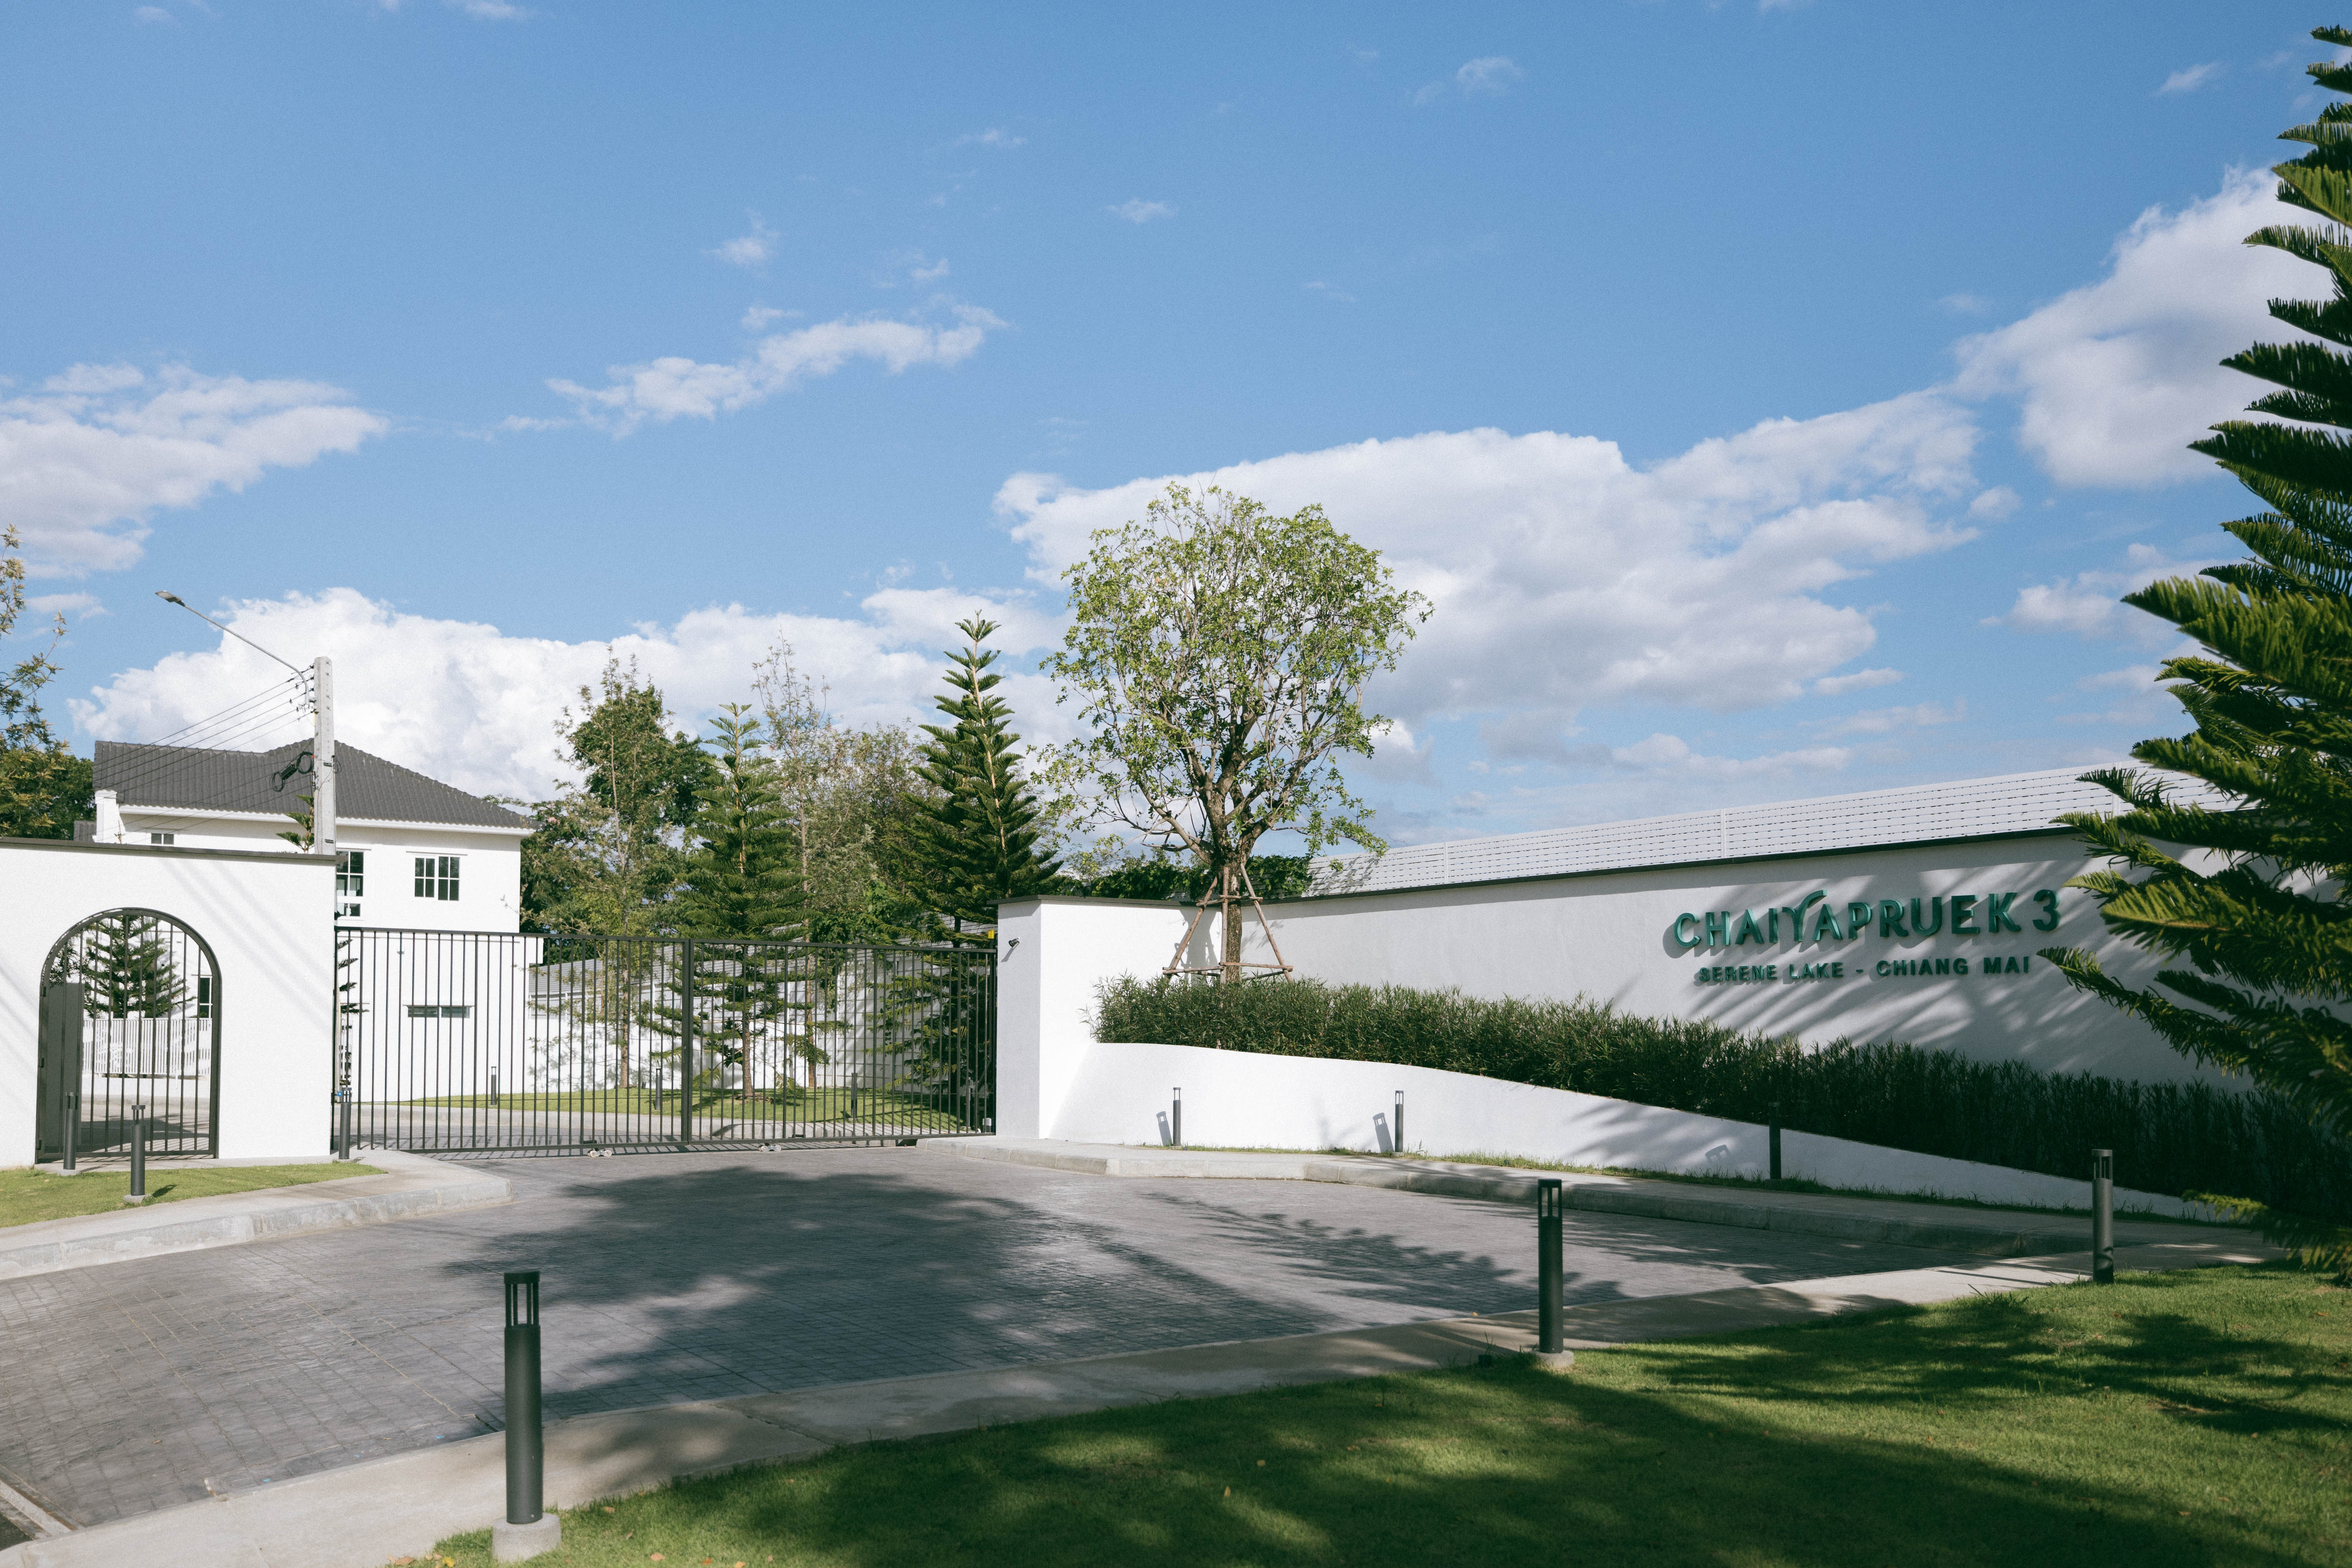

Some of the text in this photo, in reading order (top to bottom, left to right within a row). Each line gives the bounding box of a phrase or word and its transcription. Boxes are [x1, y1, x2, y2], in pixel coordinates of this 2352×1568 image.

[1673, 889, 2061, 948] CHAIYAPRUEK 3
[1699, 965, 1778, 982] SERENE
[1789, 962, 1844, 979] LAKE
[1876, 957, 1969, 977] CHIANG
[1983, 956, 2029, 975] MAI
